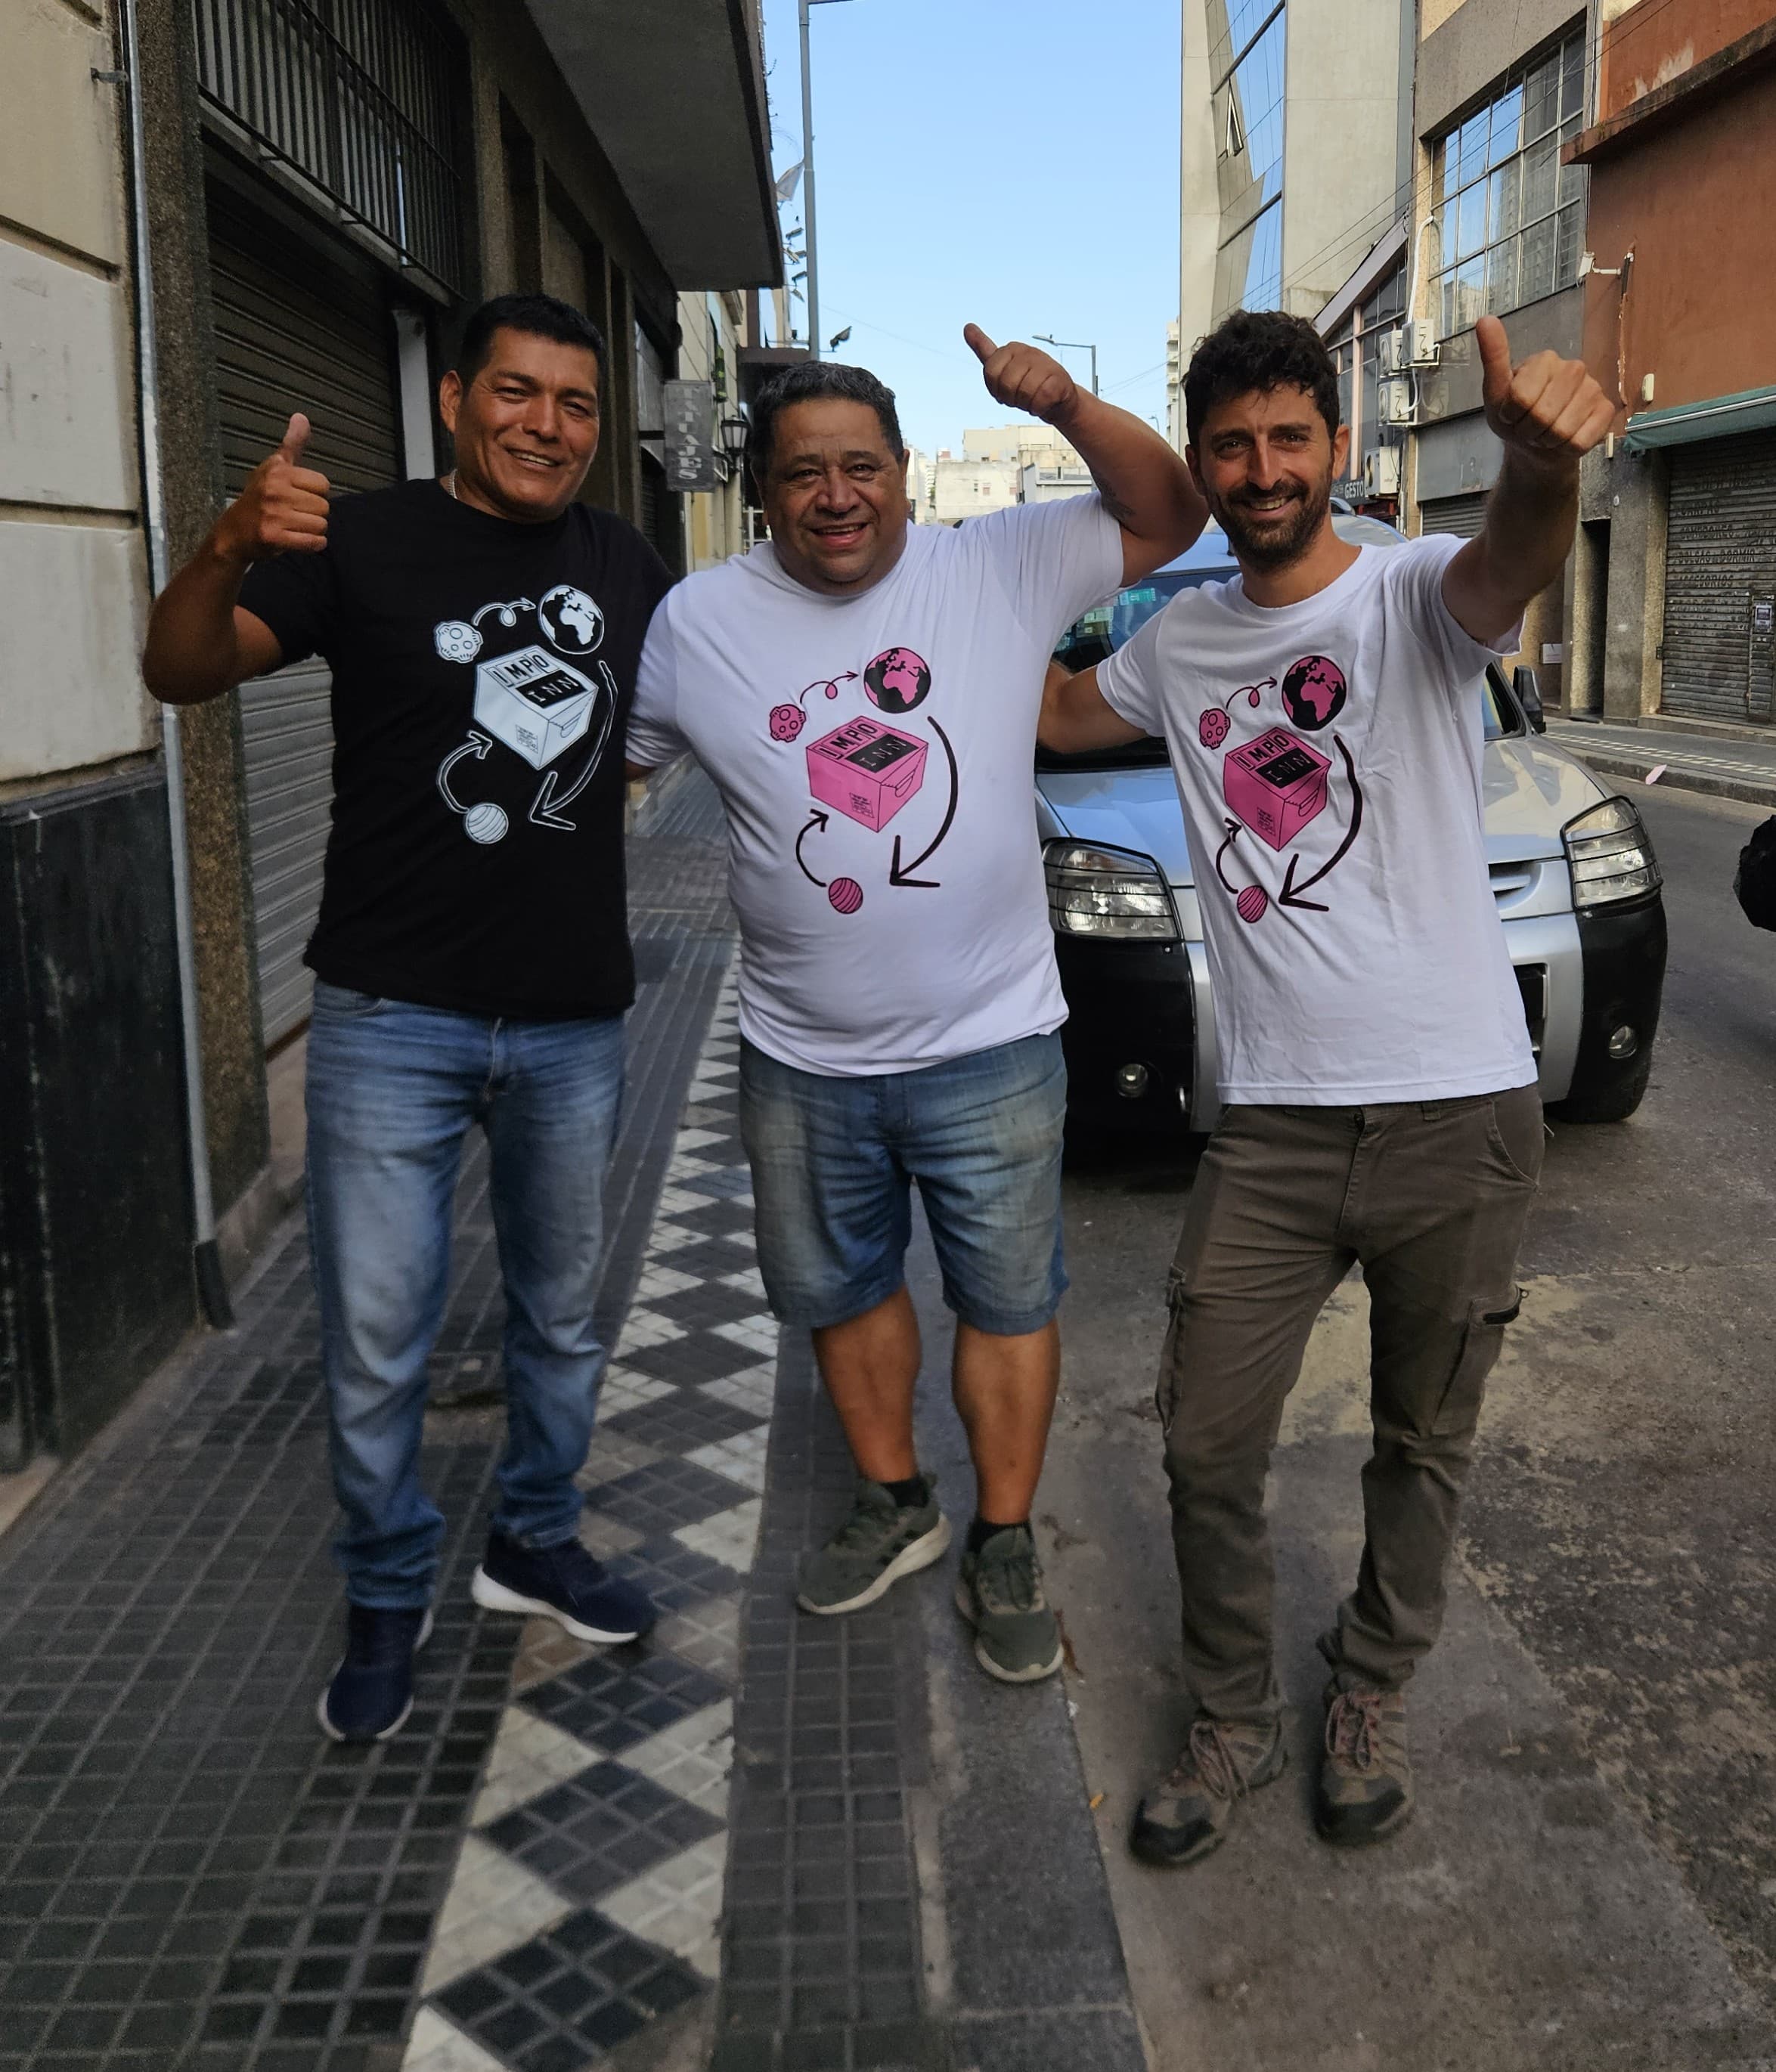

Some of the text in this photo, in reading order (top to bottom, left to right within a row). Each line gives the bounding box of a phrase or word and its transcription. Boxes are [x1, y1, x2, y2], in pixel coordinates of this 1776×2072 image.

[491, 653, 550, 685] IMPO
[819, 723, 879, 760] IMPO
[1235, 733, 1290, 768] IMPO
